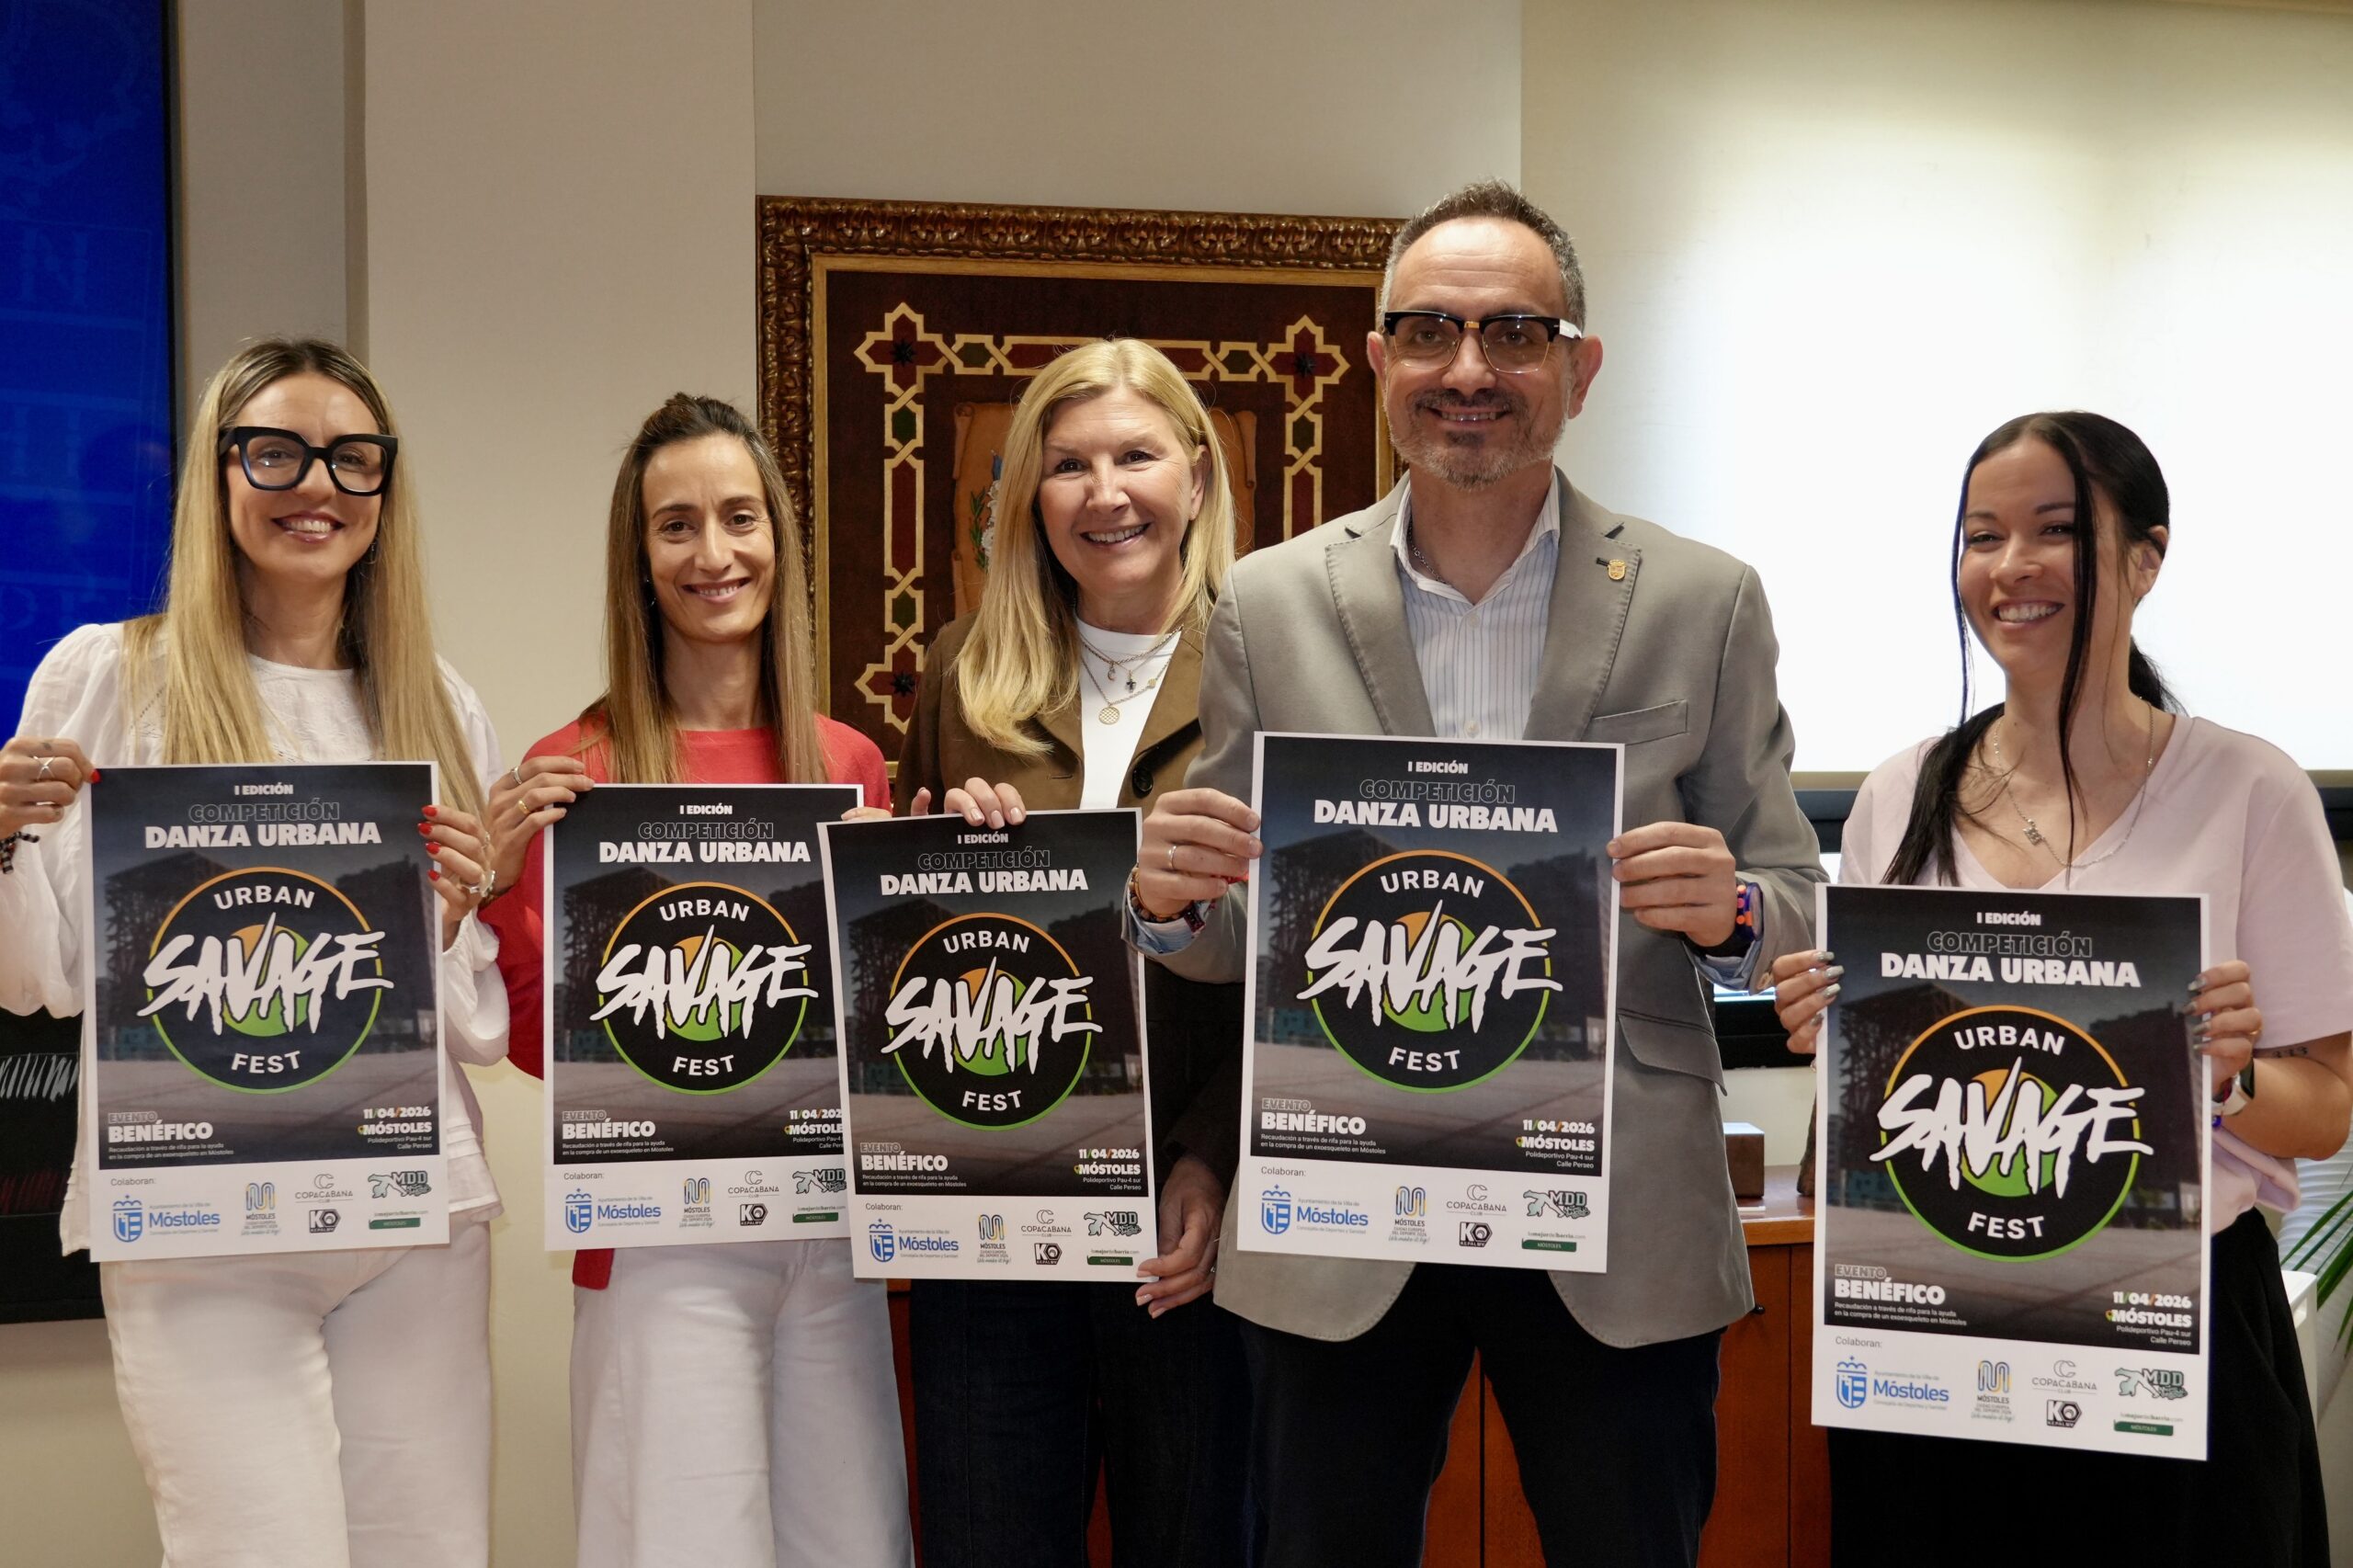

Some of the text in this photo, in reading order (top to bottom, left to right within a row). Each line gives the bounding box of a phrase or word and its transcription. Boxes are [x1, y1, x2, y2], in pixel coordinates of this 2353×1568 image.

[1407, 760, 1468, 774] I EDICIÓN
[243, 782, 293, 795] EDICIÓN
[1359, 778, 1515, 803] COMPETICIÓN
[188, 798, 338, 823] COMPETICIÓN
[679, 802, 732, 814] I EDICIÓN
[1313, 800, 1558, 833] DANZA URBANA
[145, 822, 381, 848] DANZA URBANA
[639, 818, 772, 839] COMPETICIÓN
[957, 831, 1008, 844] I EDICIÓN
[599, 841, 810, 863] DANZA URBANA
[918, 846, 1050, 869] COMPETICIÓN
[881, 869, 1088, 894] DANZA URBANA
[1381, 869, 1483, 897] URBAN
[214, 885, 313, 909] URBAN
[660, 899, 748, 921] URBAN
[1976, 911, 2040, 925] I EDICIÓN
[943, 930, 1029, 953] URBAN
[1927, 931, 2091, 957] COMPETICIÓN
[137, 912, 393, 1035] SAVAGE
[1296, 899, 1563, 1033] SAVAGE
[1881, 953, 2139, 988] DANZA URBANA
[589, 924, 818, 1039] SAVAGE
[881, 956, 1103, 1074] SAVAGE
[1955, 1026, 2064, 1055] URBAN
[231, 1051, 299, 1074] FEST
[672, 1054, 733, 1075] FEST
[1388, 1047, 1460, 1072] FEST
[962, 1090, 1020, 1110] FEST
[1261, 1097, 1311, 1111] EVENTO
[108, 1110, 157, 1124] EVENTO
[563, 1109, 606, 1121] EVENTO
[790, 1108, 843, 1119] 11/04/202
[1261, 1109, 1366, 1134] BENÉFICO
[108, 1119, 212, 1143] BENÉFICO
[563, 1118, 655, 1140] BENÉFICO
[790, 1121, 843, 1135] MÓSTOLE
[1522, 1119, 1595, 1134] 11/04/2026
[1870, 1056, 2153, 1198] SAVAGE
[859, 1142, 901, 1153] EVENTO
[1313, 1144, 1350, 1153] exoesqueleto
[1521, 1134, 1595, 1152] MÓSTOLES
[860, 1151, 949, 1170] BENÉFICO
[1078, 1148, 1140, 1159] 11/04/2026
[1525, 1151, 1564, 1159] Polideportivo
[563, 1171, 604, 1180] Colaboran:
[813, 1168, 846, 1182] MDD
[1079, 1162, 1140, 1175] MÓSTOLES
[1261, 1166, 1306, 1176] Colaboran:
[727, 1185, 779, 1194] COPACABANA
[1548, 1190, 1587, 1207] MDD
[597, 1202, 661, 1220] Móstoles
[684, 1206, 710, 1214] MÓSTOLES
[1446, 1200, 1506, 1212] COPACABANA
[149, 1209, 220, 1228] Móstoles
[1105, 1211, 1138, 1224] MDD
[1297, 1206, 1369, 1226] Móstoles
[1394, 1218, 1425, 1227] MÓSTOLES
[1968, 1212, 2043, 1239] FEST
[899, 1236, 959, 1251] Móstoles
[1835, 1264, 1886, 1279] EVENTO
[1835, 1278, 1945, 1304] BENÉFICO
[2113, 1290, 2192, 1309] 11/04/2026
[2112, 1308, 2191, 1327] MÓSTOLES
[2117, 1325, 2158, 1335] Polideportivo
[1836, 1336, 1882, 1347] Colaboran:
[2168, 1337, 2191, 1346] Perseo
[2031, 1377, 2097, 1391] COPACABANA
[2142, 1369, 2184, 1387] MDD
[1873, 1379, 1949, 1402] Móstoles
[1976, 1393, 2009, 1404] MÓSTOLES
